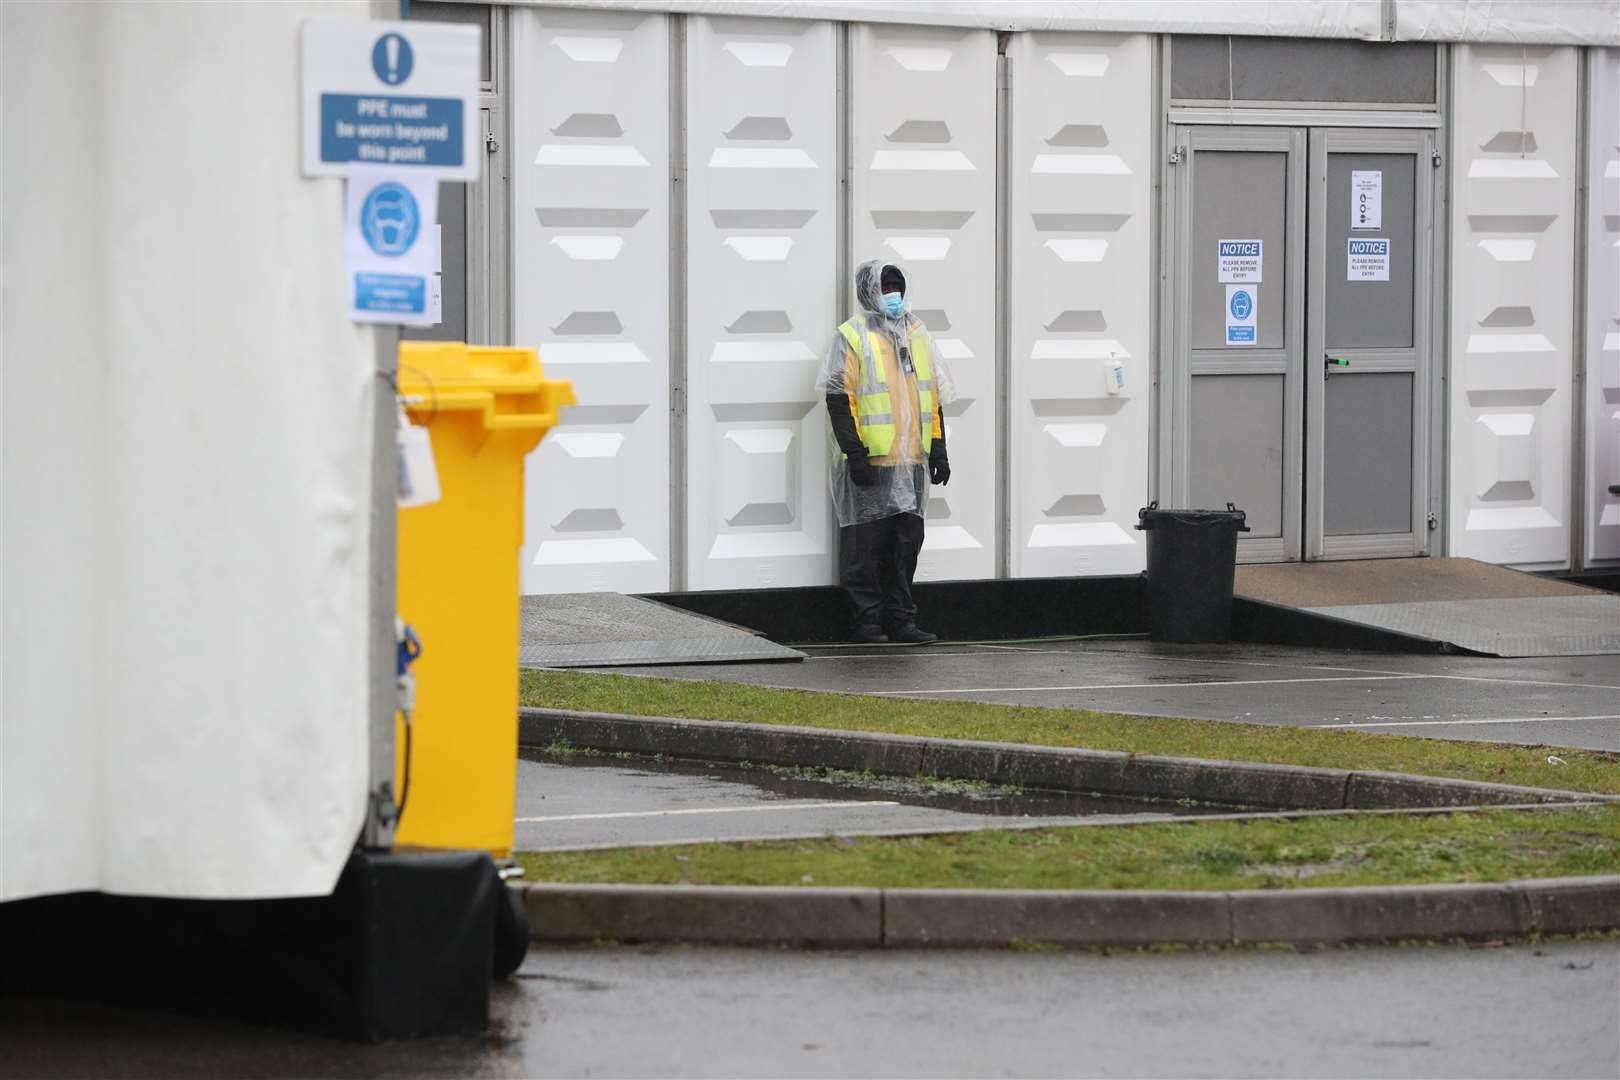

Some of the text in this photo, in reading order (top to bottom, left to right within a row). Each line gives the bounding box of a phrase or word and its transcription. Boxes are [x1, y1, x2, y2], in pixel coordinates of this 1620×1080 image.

[357, 99, 428, 118] PPE must
[336, 120, 449, 143] be worn beyond
[358, 143, 426, 162] this point
[1222, 243, 1258, 254] NOTICE
[1351, 242, 1385, 254] NOTICE
